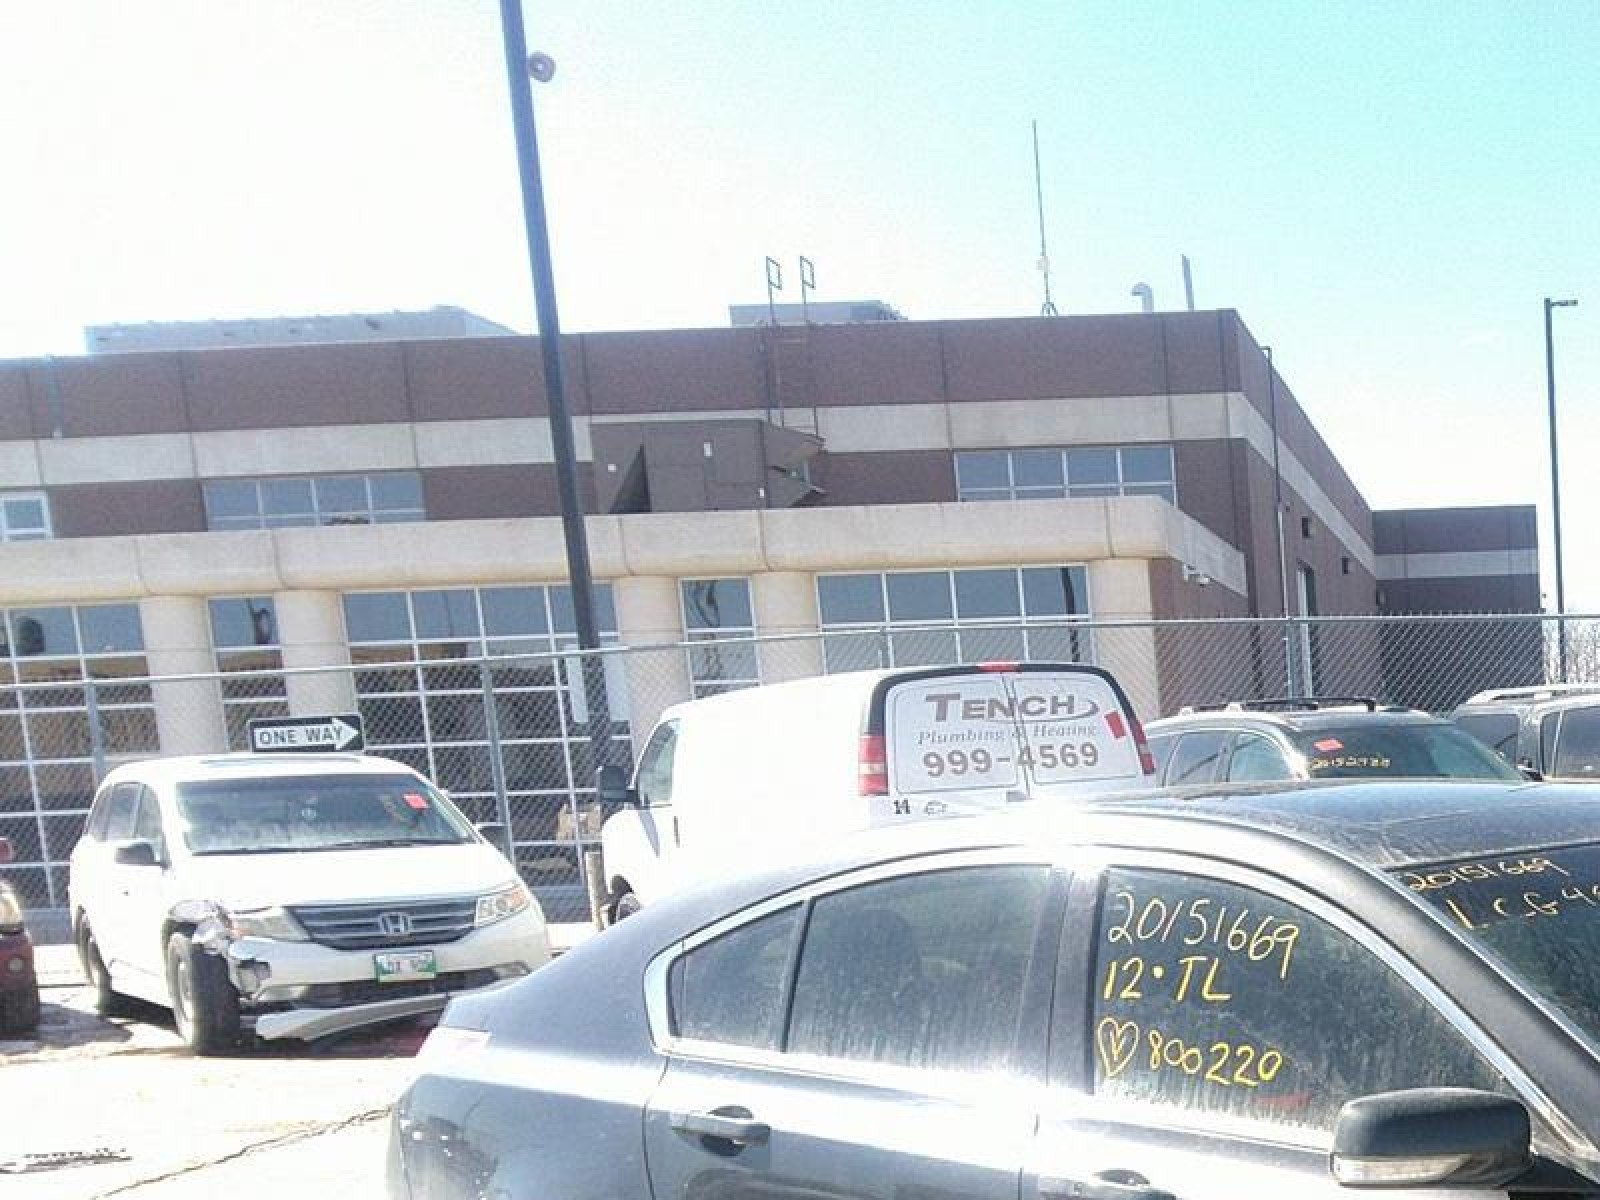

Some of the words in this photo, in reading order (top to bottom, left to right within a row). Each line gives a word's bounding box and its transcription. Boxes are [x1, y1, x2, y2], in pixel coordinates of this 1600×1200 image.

[259, 728, 297, 745] ONE
[305, 725, 343, 742] WAY
[917, 729, 1006, 745] Plumbing
[1033, 725, 1097, 738] Heating
[923, 742, 1099, 777] 999-4569
[1107, 892, 1299, 979] 20151669
[1148, 1029, 1283, 1086] 800220
